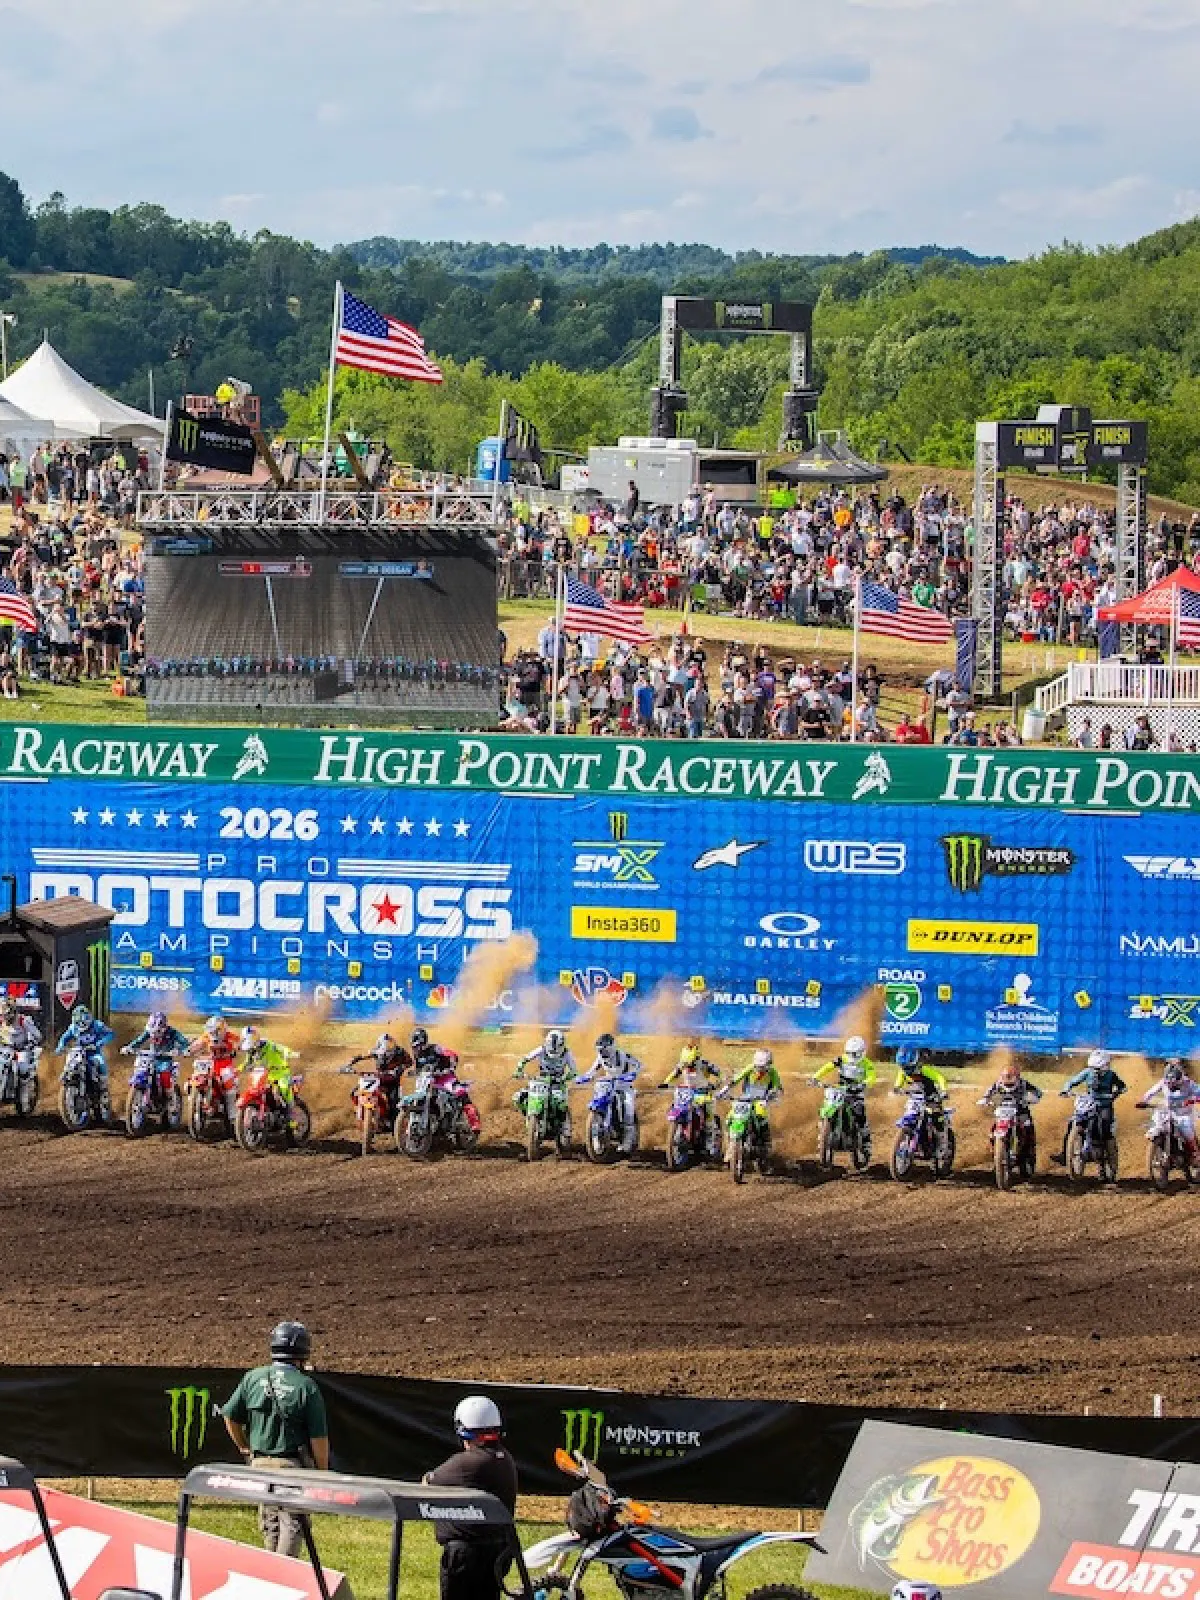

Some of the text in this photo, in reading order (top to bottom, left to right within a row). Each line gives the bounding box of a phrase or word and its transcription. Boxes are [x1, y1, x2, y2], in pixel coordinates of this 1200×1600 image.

[1015, 427, 1055, 446] FINISH
[1094, 427, 1131, 445] FINISH
[10, 727, 219, 778] RACEWAY
[313, 736, 836, 797] HIGH POINT RACEWAY
[940, 753, 1080, 806] HIGH
[219, 806, 319, 841] 2026
[207, 854, 329, 876] PRO
[571, 847, 659, 882] SMX
[804, 840, 907, 875] WPS
[985, 847, 1071, 865] MONSTER
[587, 914, 661, 934] Insta360
[743, 935, 838, 951] OAKLEY
[931, 930, 1033, 945] DUNLOP
[877, 967, 927, 982] ROAD
[209, 977, 267, 999] AMA
[713, 993, 821, 1009] MARINES
[894, 993, 912, 1013] 2
[878, 1021, 931, 1035] ECOVERY
[605, 1414, 701, 1447] MONSTER
[619, 1446, 686, 1457] ENERGY
[938, 1461, 1015, 1501] Bass
[418, 1502, 487, 1520] Kawasaki
[926, 1495, 987, 1533] Pro
[1118, 1489, 1200, 1553] TR
[915, 1527, 1009, 1579] Shops
[1066, 1554, 1195, 1599] BOATS
